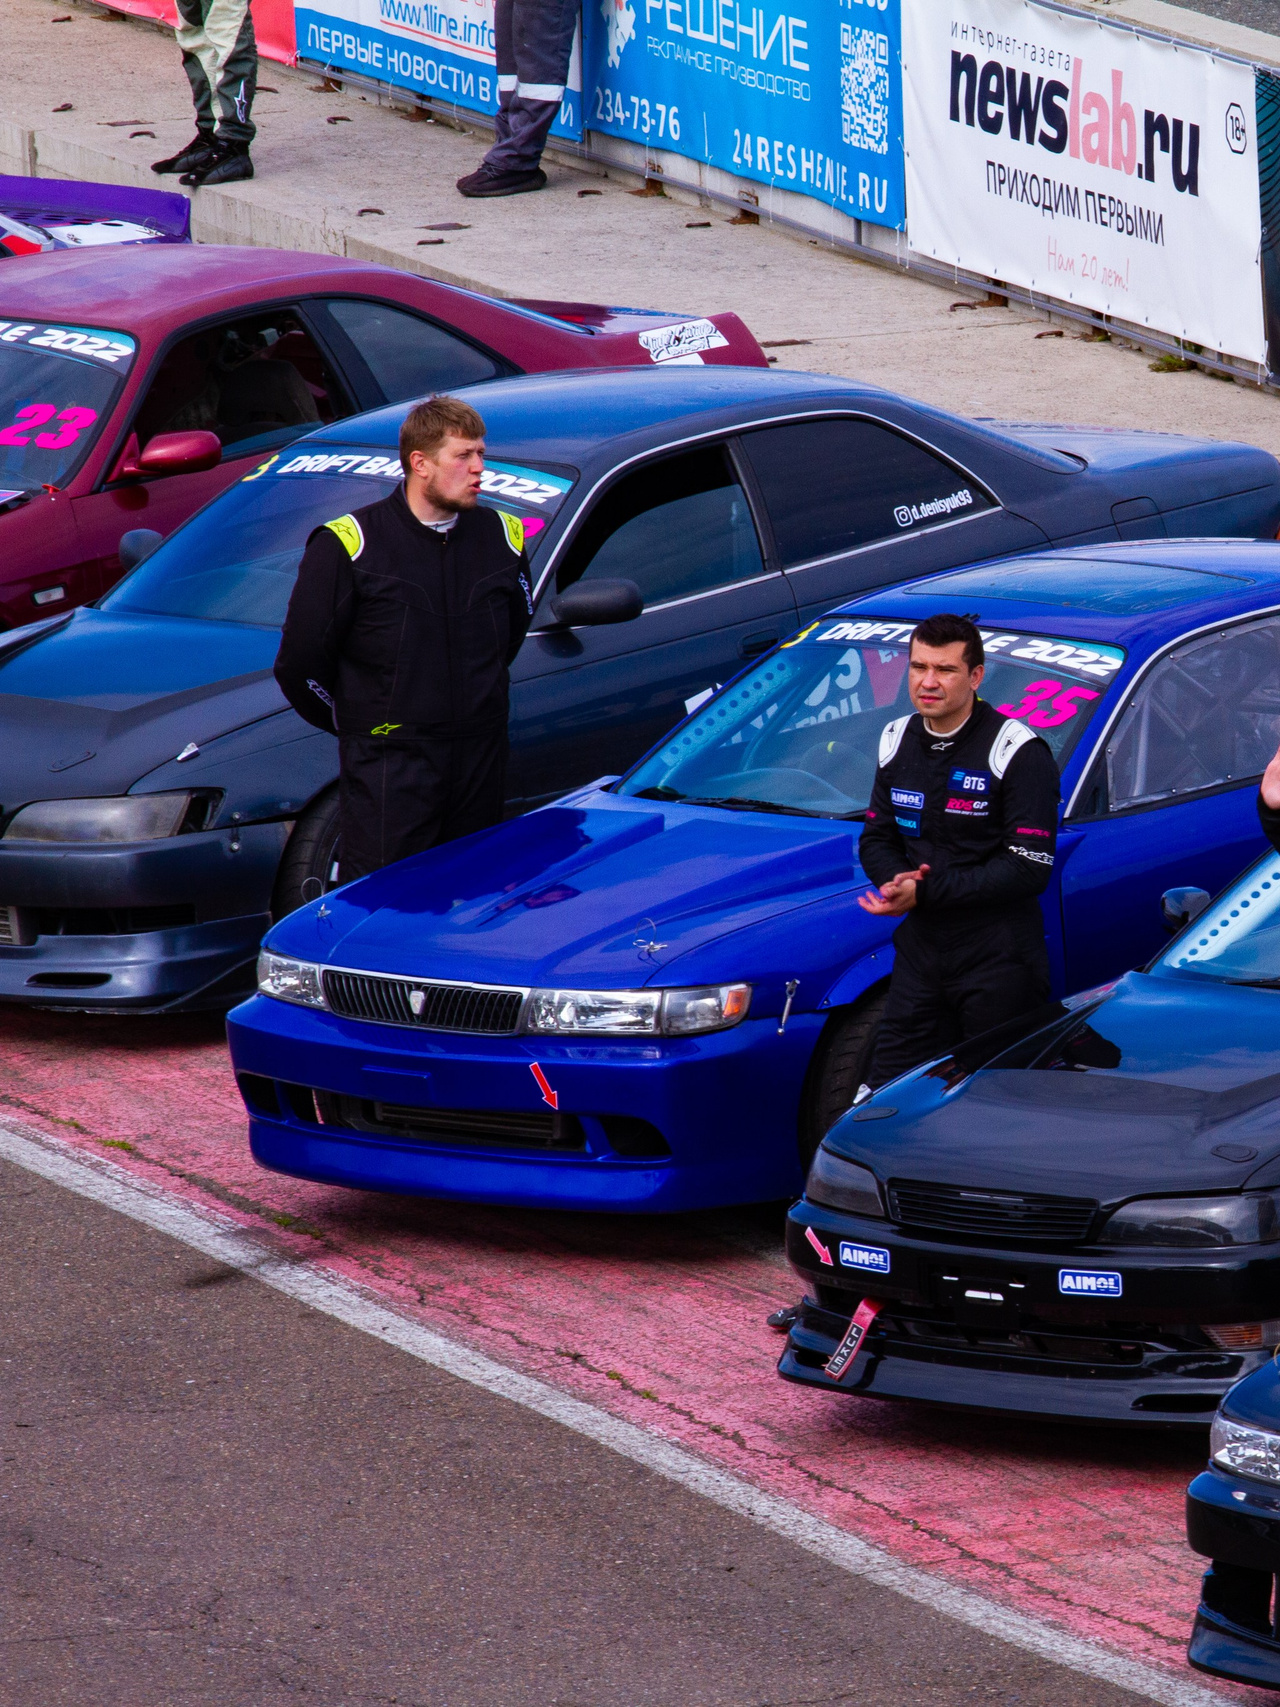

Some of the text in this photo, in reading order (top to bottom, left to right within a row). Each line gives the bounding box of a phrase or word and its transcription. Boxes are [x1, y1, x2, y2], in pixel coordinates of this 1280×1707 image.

[307, 23, 491, 102] ПЕРВЫЕ НОВОСТИ В
[647, 36, 811, 102] РЕКЛАМНОЕ ПРОИЗВОДСТВО
[951, 20, 1071, 72] интернет-газета
[595, 86, 681, 141] 234-73-76
[950, 49, 1200, 198] newslab.ru
[1229, 114, 1247, 142] 18+
[733, 128, 889, 214] 24RESHENIE.RU
[986, 160, 1165, 247] ПРИХОДИМ ПЕРВЫМИ
[1047, 236, 1131, 292] Нам 20 лет!
[28, 328, 134, 363] 2022
[0, 404, 98, 450] 23
[480, 471, 562, 503] 2022
[911, 489, 973, 520] d.denisyuk93
[1011, 639, 1123, 677] 2022
[996, 679, 1100, 729] 35
[963, 776, 986, 791] ВТБ
[842, 1247, 887, 1270] AIMOL
[1062, 1275, 1119, 1292] AIMOL
[833, 1327, 860, 1366] LUKE
